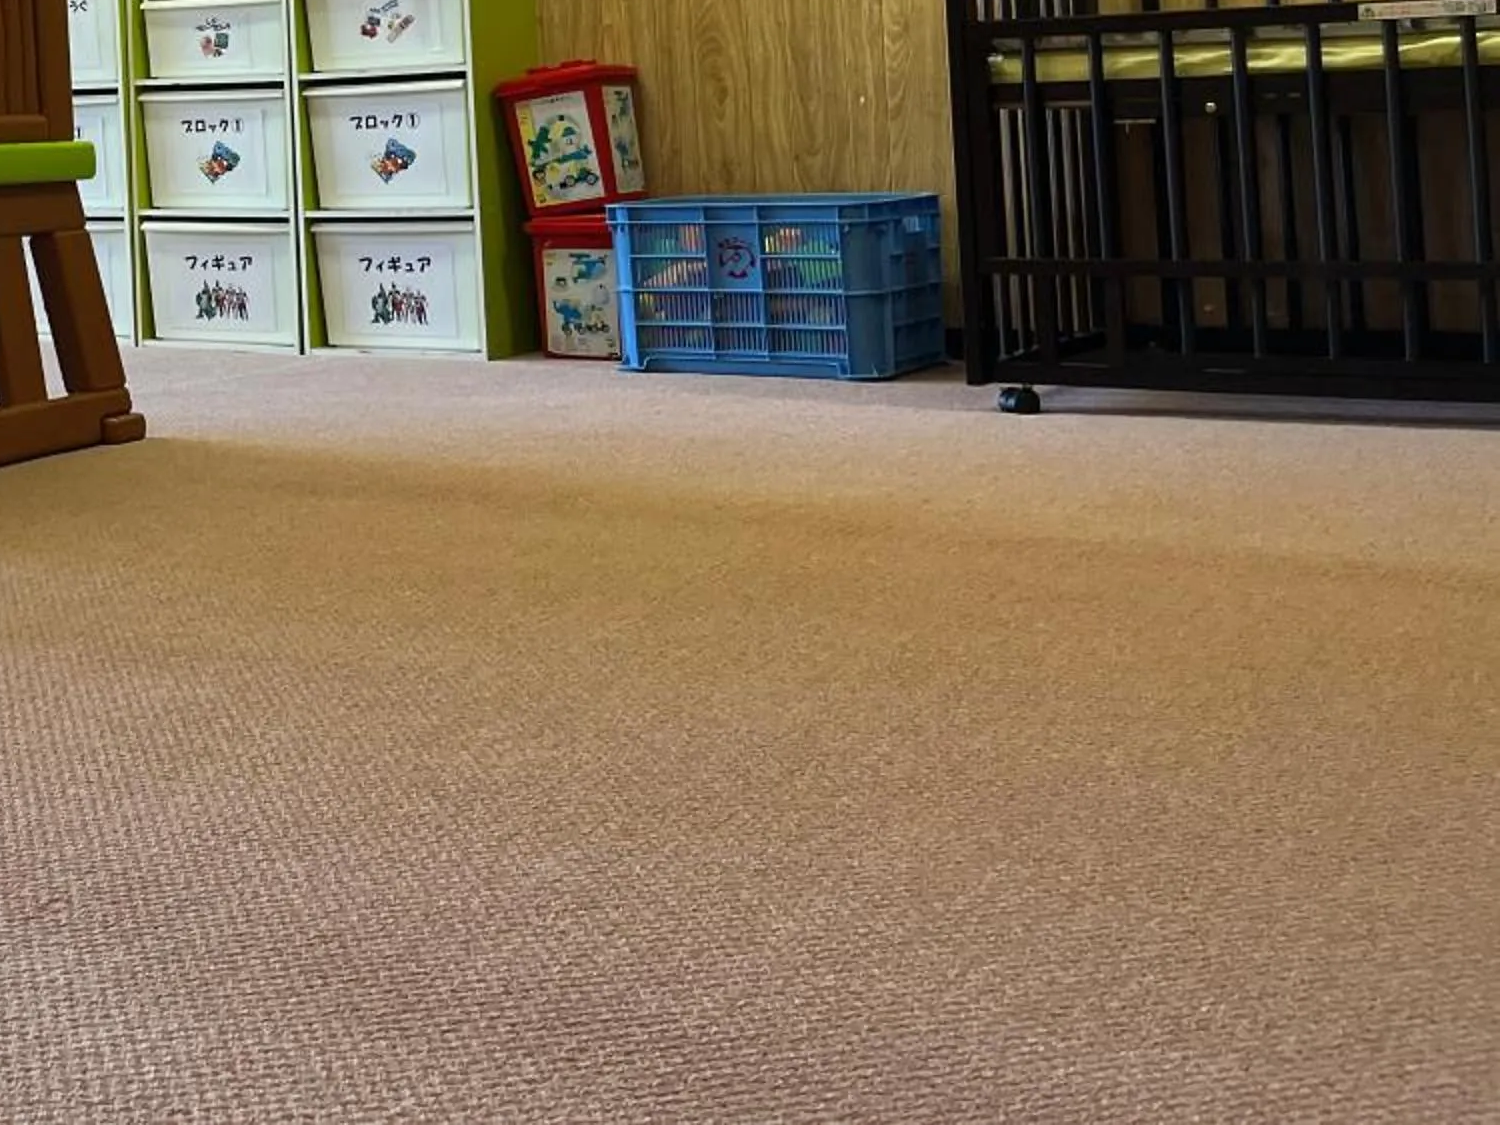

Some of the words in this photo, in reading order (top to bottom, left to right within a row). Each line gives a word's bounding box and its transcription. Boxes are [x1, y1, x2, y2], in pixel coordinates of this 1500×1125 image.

[184, 254, 253, 272] フィギュア
[359, 256, 431, 273] フィギュア
